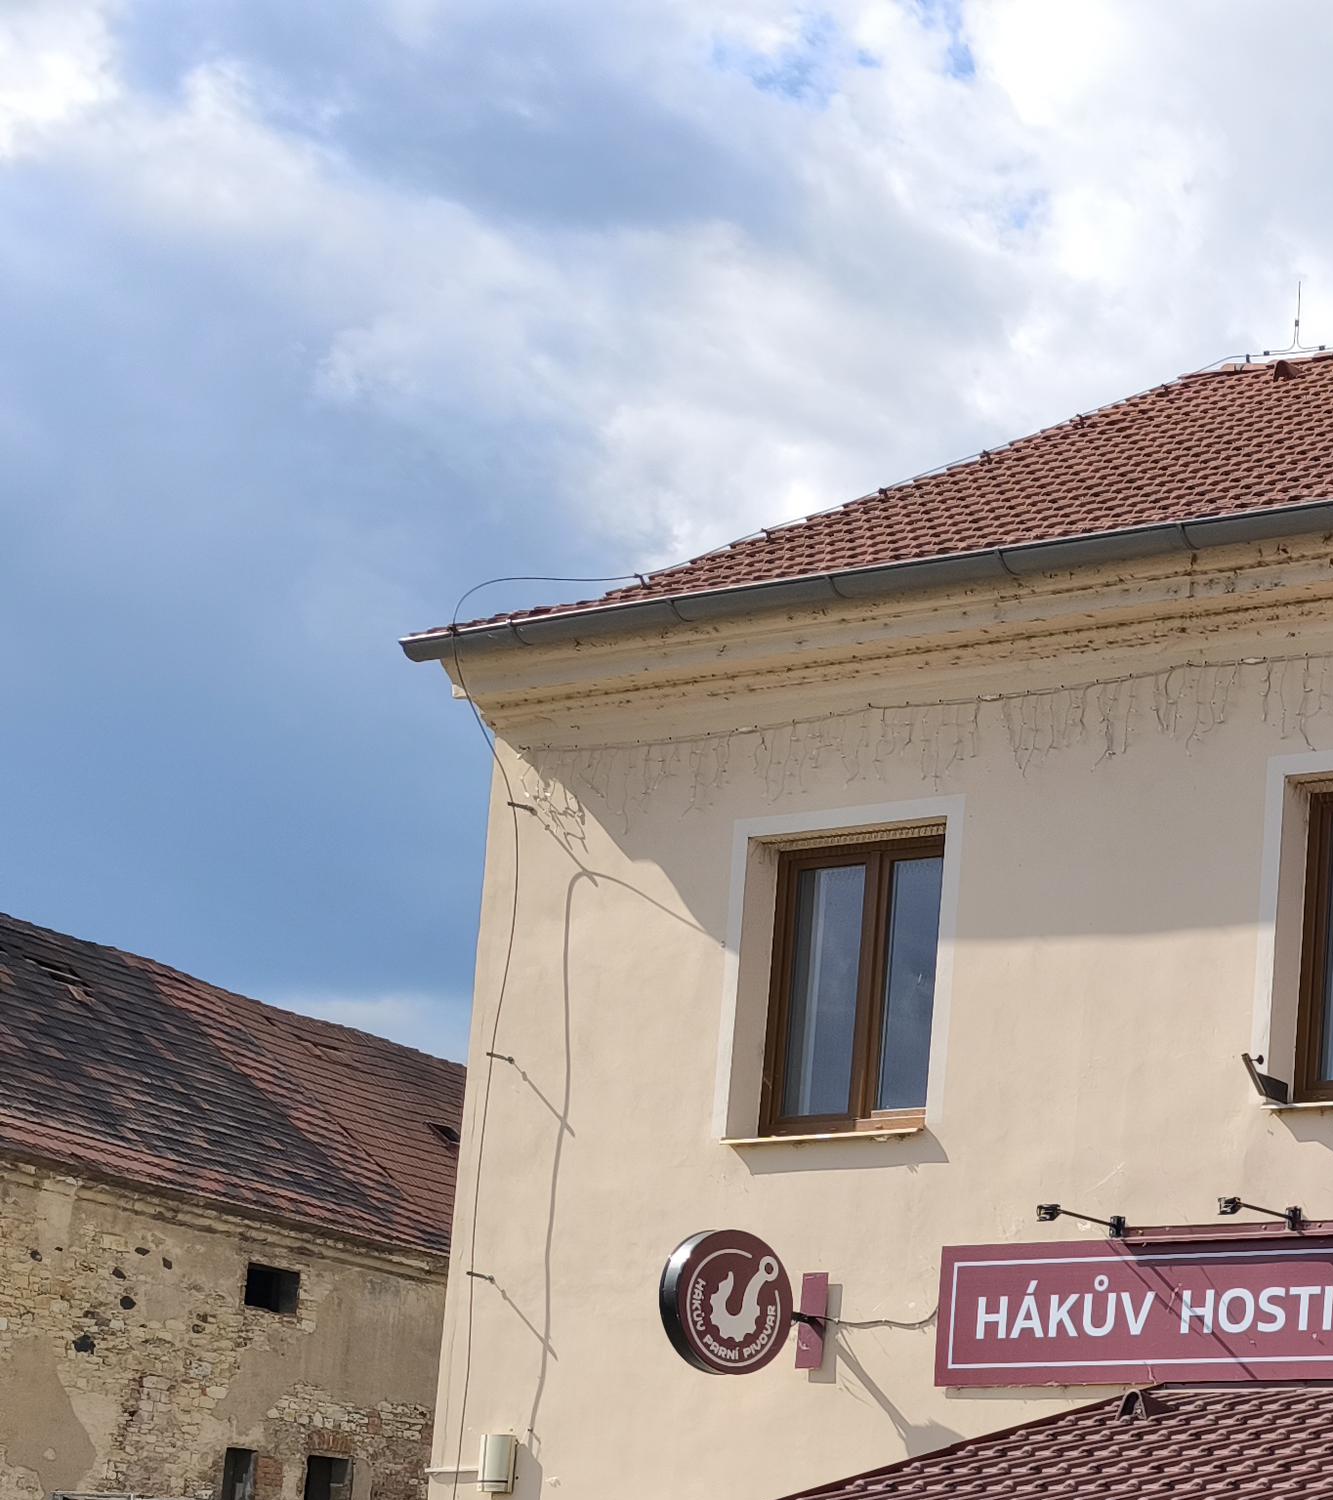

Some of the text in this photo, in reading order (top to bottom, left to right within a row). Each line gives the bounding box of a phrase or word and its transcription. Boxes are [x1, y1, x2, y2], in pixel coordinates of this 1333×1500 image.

[692, 1278, 776, 1360] HÁKŮV PARNÍ PIVOVAR
[976, 1275, 1155, 1339] HÁKŮV
